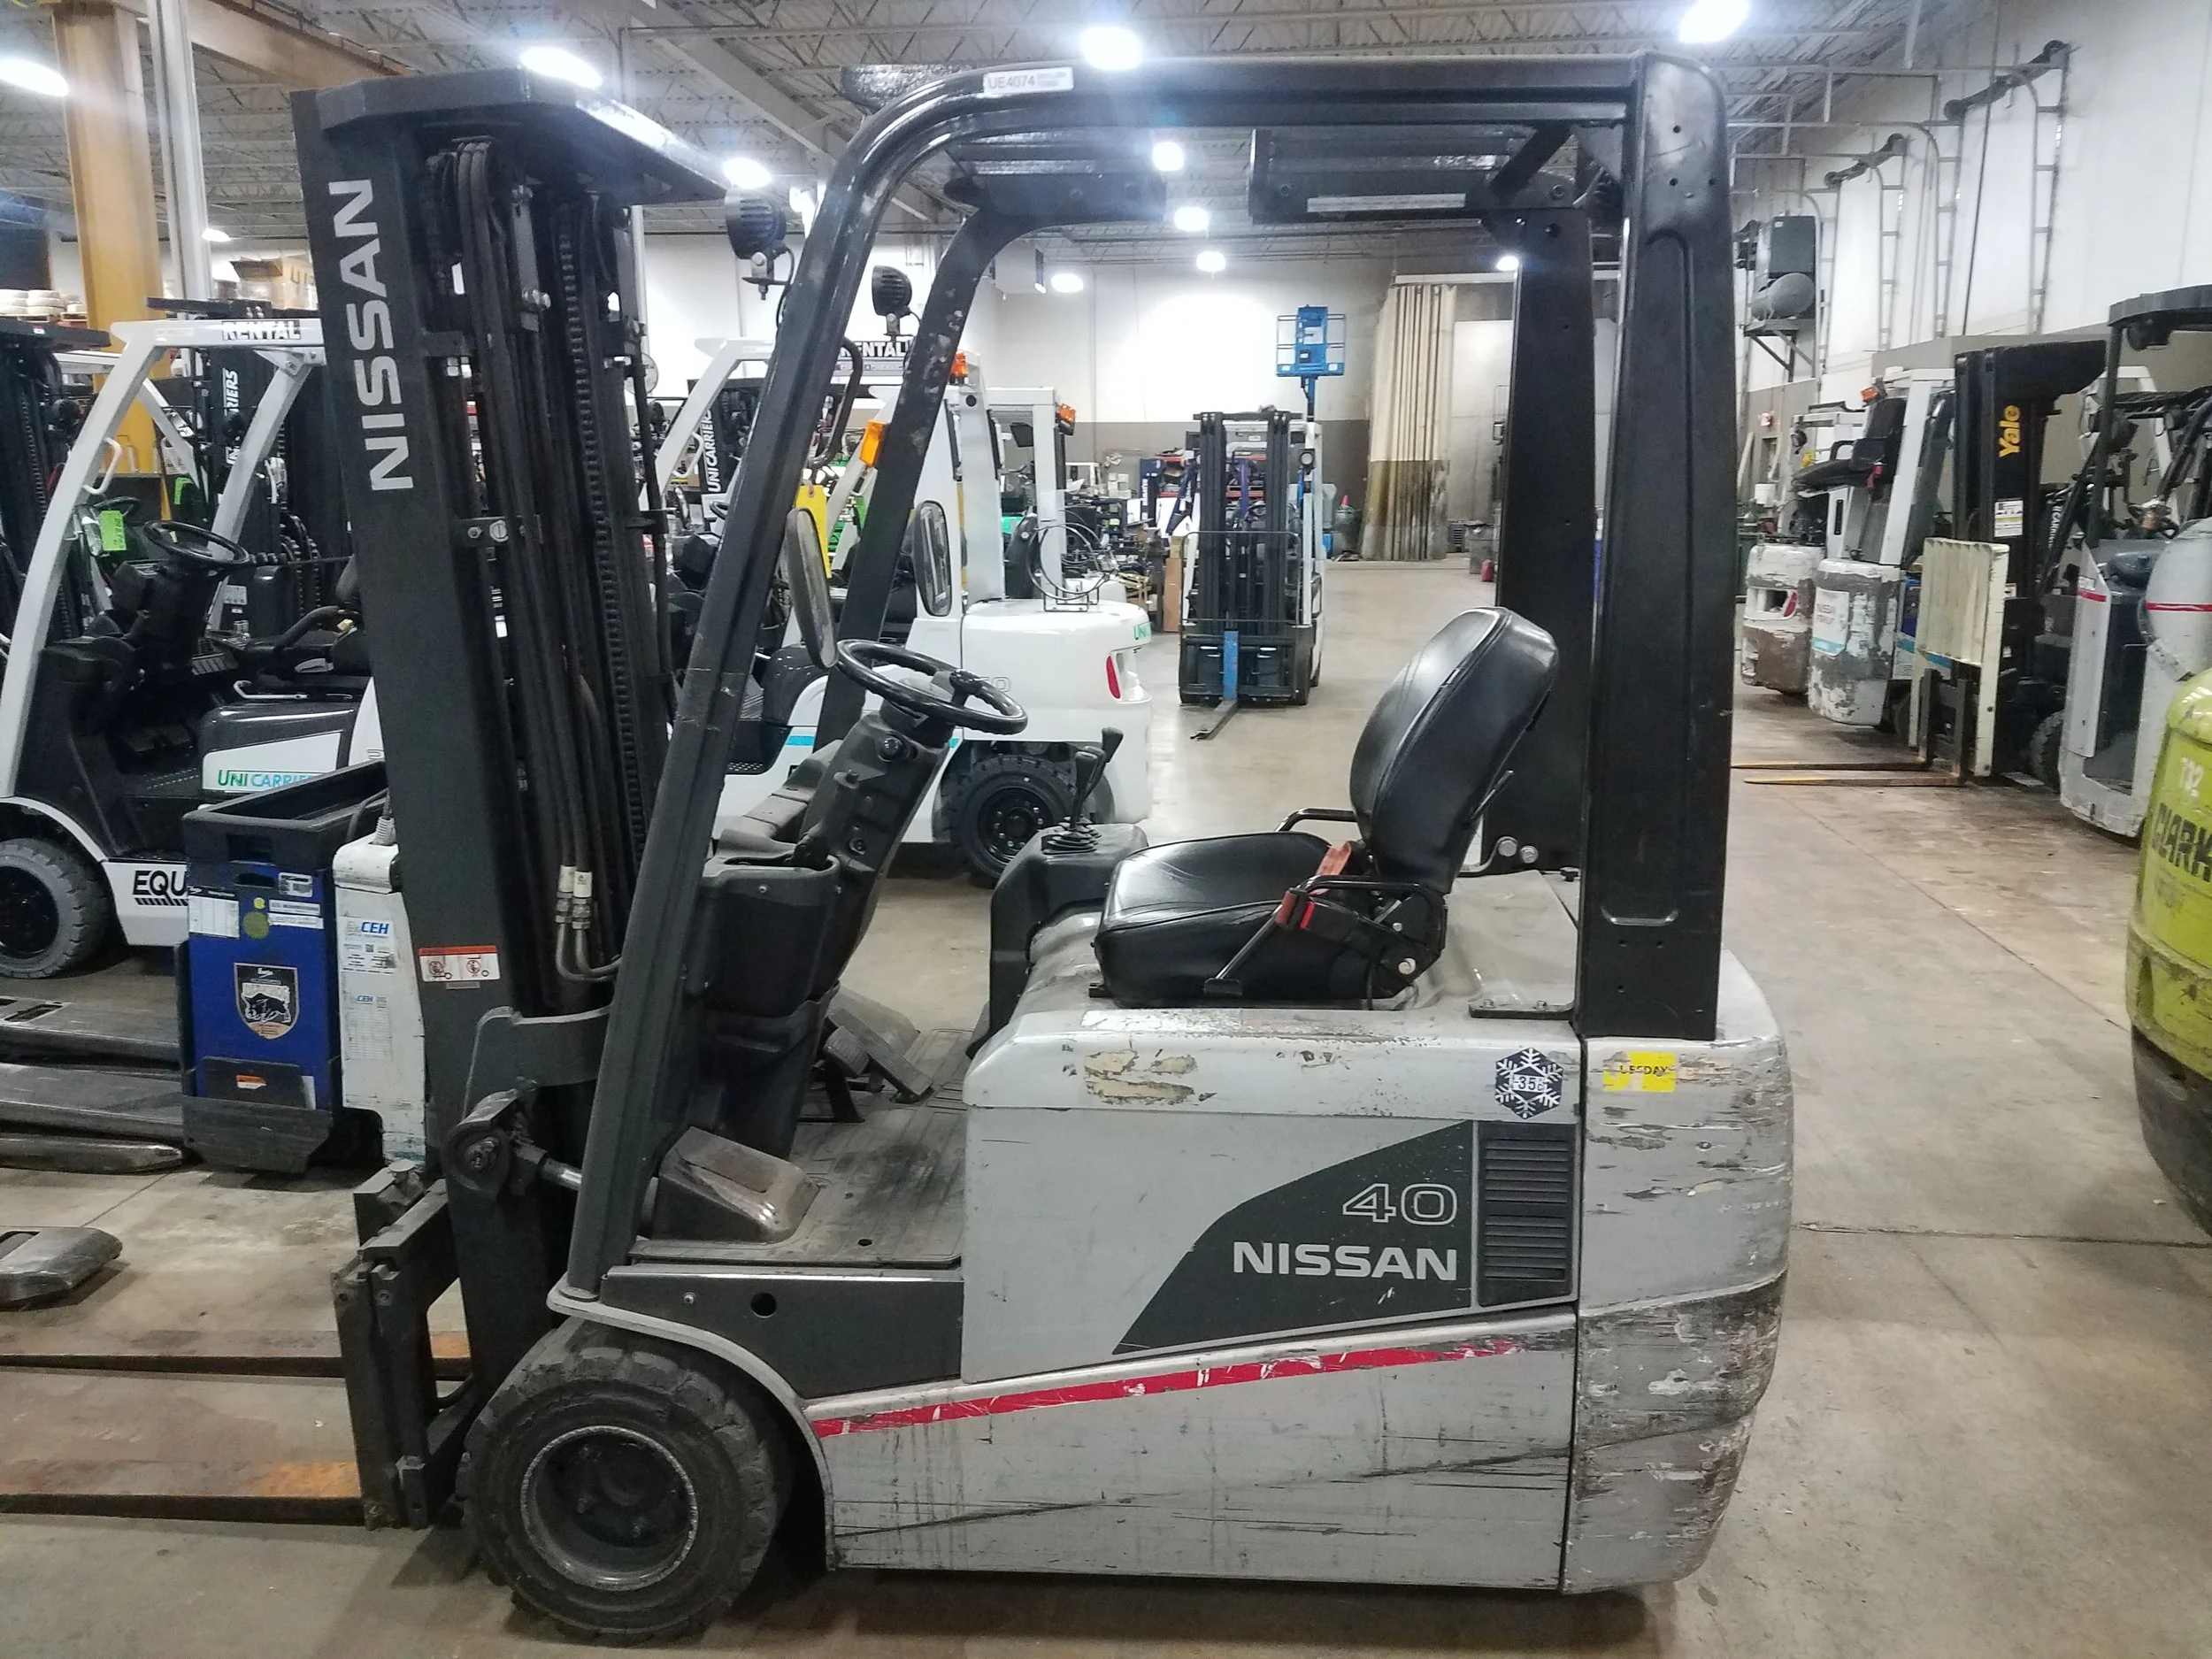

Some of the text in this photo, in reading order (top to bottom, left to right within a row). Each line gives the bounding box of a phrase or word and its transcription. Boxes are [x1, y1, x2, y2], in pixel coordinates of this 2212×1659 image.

[328, 179, 413, 491] NISSAN
[1998, 404, 2021, 458] Yale
[361, 921, 389, 934] CEH
[1342, 1183, 1457, 1225] 40
[1233, 1241, 1457, 1281] NISSAN
